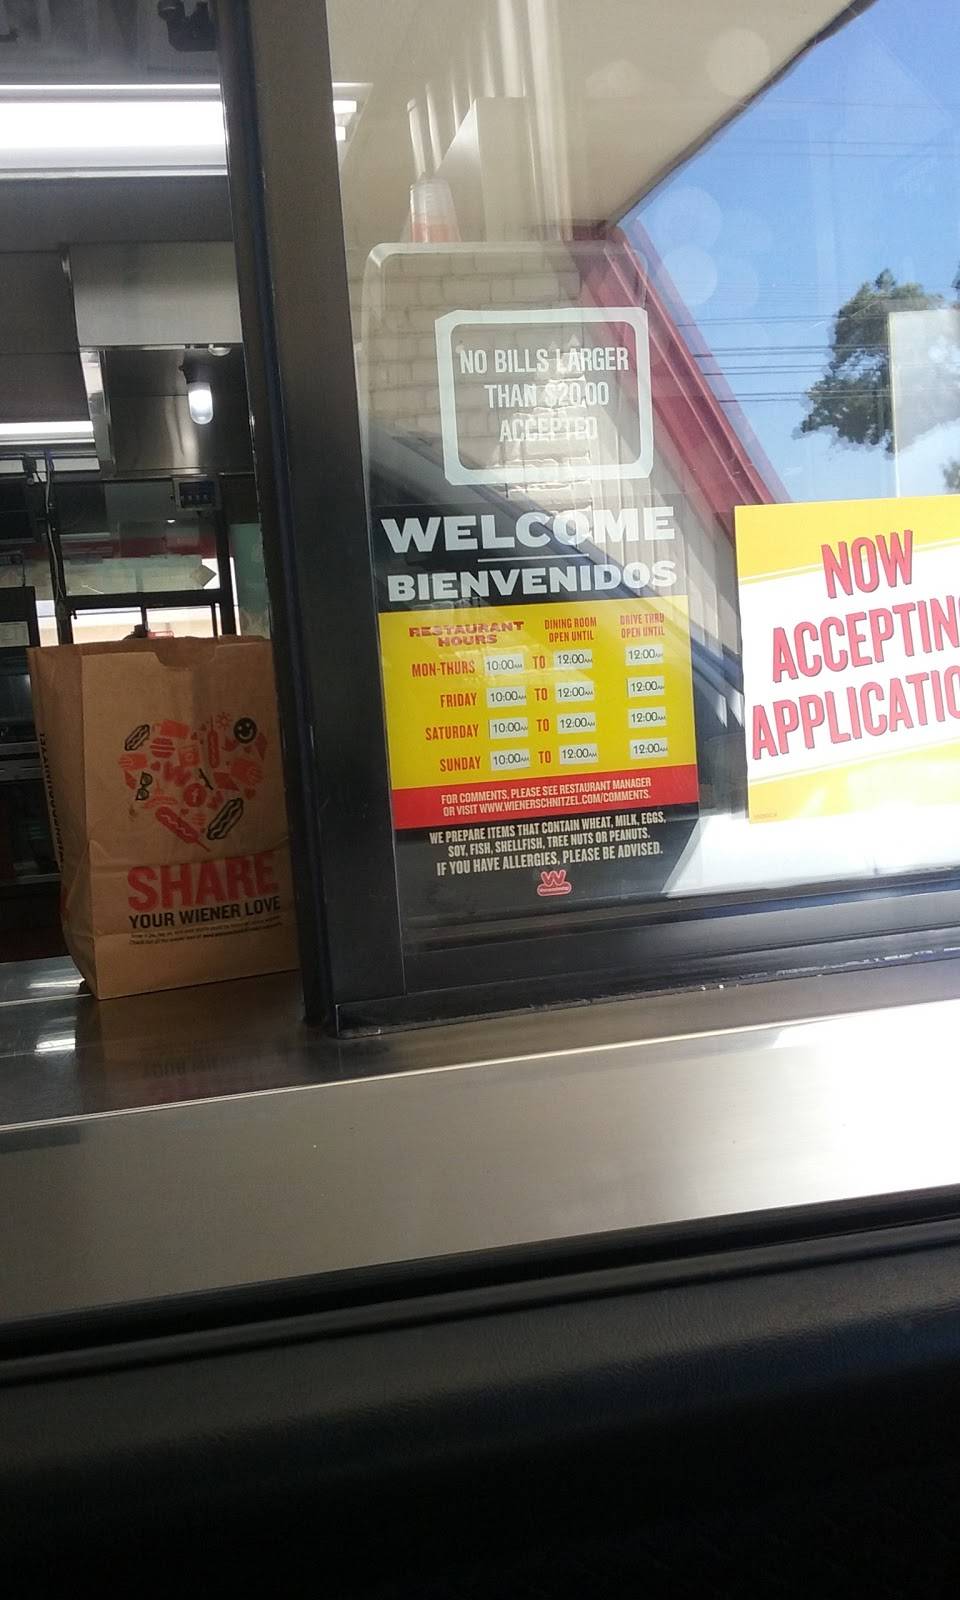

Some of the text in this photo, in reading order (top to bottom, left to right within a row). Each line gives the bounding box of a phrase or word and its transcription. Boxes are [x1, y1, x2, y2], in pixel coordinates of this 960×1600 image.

[460, 347, 629, 374] NO BILLS LARGER
[484, 381, 609, 408] THAN $20.00
[499, 416, 598, 442] ACCEPTED
[381, 507, 674, 553] WELCOME
[821, 529, 914, 599] NOW
[387, 560, 677, 602] BIENVENIDOS
[408, 621, 524, 637] RESTAURANT
[544, 616, 597, 630] DINING ROOM
[620, 614, 643, 625] DRIVE
[621, 625, 665, 639] OPEN UNTIL
[438, 634, 497, 647] HOURS
[549, 631, 594, 643] OPEN UNTIL
[772, 594, 960, 683] ACCEPTIN
[412, 661, 475, 678] MON-THURS
[532, 655, 546, 669] TO
[440, 693, 477, 708] FRIDAY
[534, 688, 548, 701] TO
[425, 724, 479, 740] SATURDAY
[536, 719, 550, 732] TO
[440, 756, 481, 772] SUNDAY
[538, 751, 551, 764] TO
[441, 777, 652, 805] FOR COMMENTS, PLEASE SEE RESTAURANT MANAGER
[443, 806, 456, 817] OR
[457, 804, 478, 816] VISIT
[429, 811, 667, 844] WE PREPARE ITEMS THAT CONTAIN WHEAT, MILK, EGGS,
[470, 842, 494, 856] FISH,
[495, 837, 545, 853] SHELLFISH,
[547, 835, 569, 848] TREE
[570, 832, 594, 846] NUTS
[595, 831, 608, 843] OR
[609, 827, 651, 842] PEANUTS.
[436, 841, 664, 876] IF YOU HAVE ALLERGIES, PLEASE BE ADVISED.
[128, 851, 279, 912] SHARE
[128, 912, 175, 929] YOUR
[179, 903, 240, 925] WIENER
[245, 895, 281, 916] LOVE
